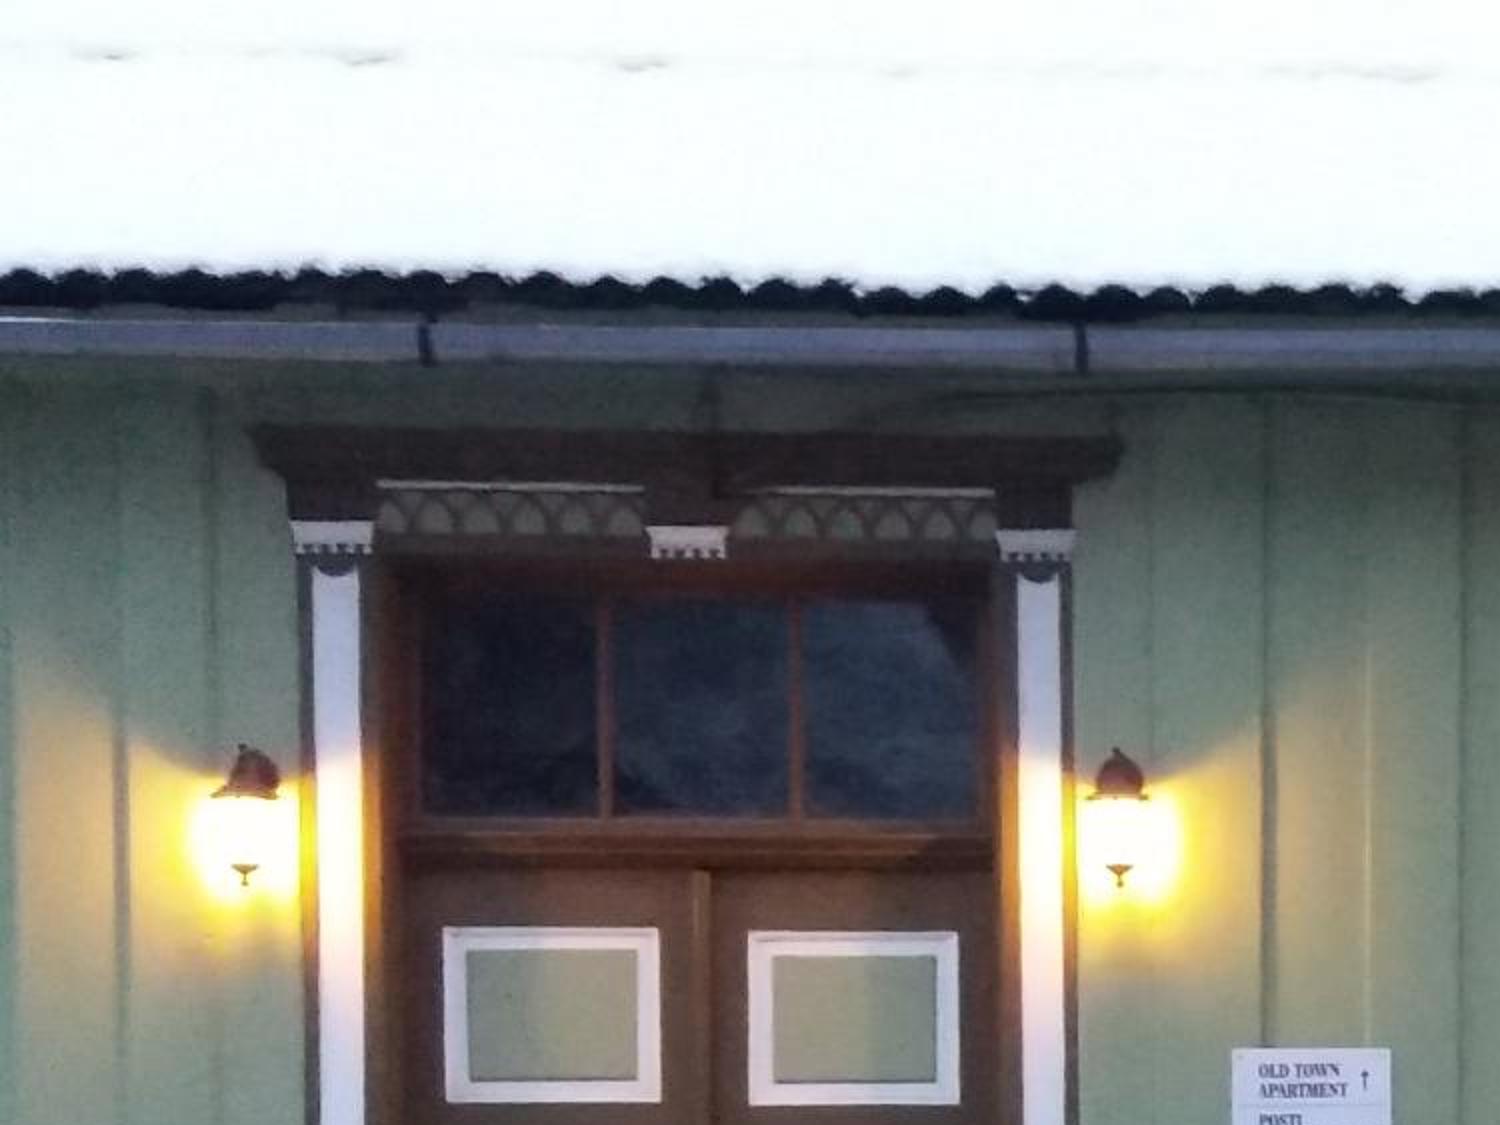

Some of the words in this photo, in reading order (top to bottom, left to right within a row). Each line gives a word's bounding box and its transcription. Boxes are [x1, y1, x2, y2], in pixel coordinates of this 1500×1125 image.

[1258, 1063, 1289, 1078] OLD
[1294, 1063, 1341, 1078] TOWN
[1258, 1083, 1348, 1099] APARTMENT
